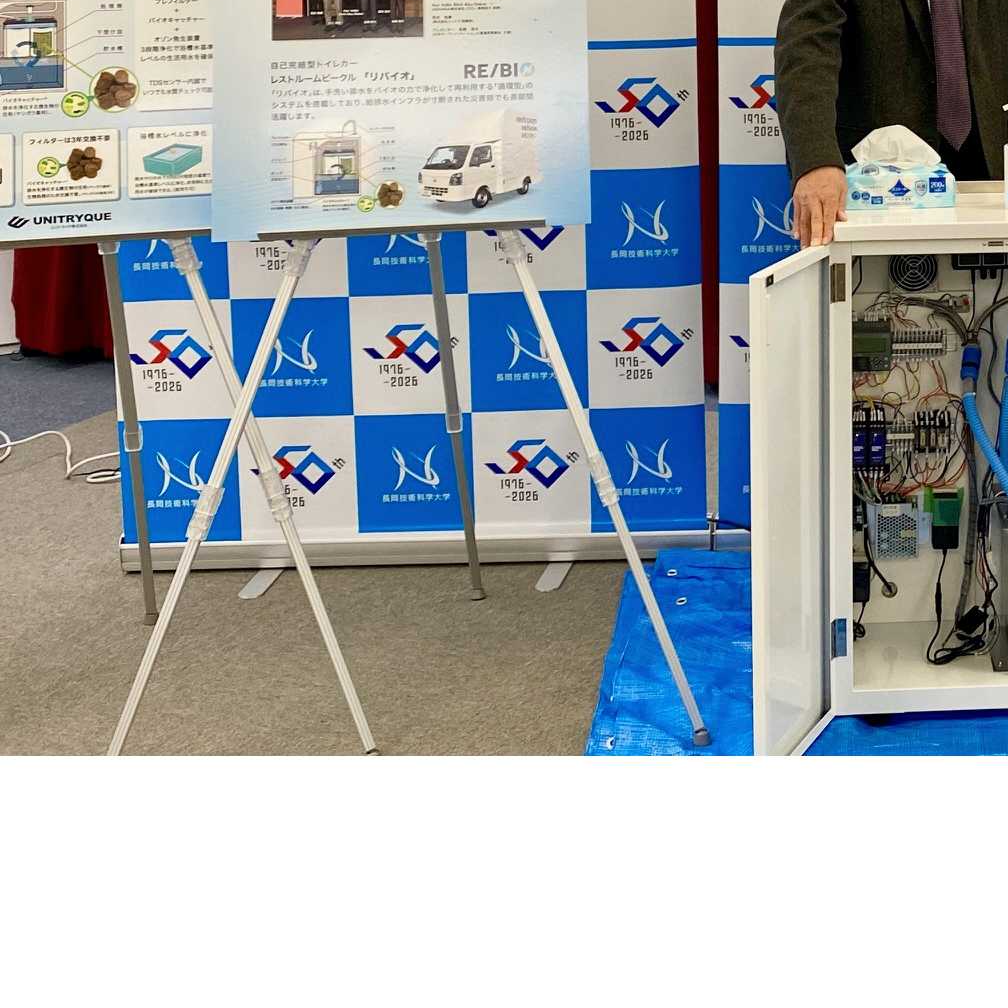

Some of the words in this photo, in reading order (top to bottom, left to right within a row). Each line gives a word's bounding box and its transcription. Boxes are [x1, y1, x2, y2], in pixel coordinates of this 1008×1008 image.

[614, 130, 649, 141] -2026
[746, 126, 780, 137] -2026
[33, 213, 112, 225] UNITRYQUE
[611, 247, 679, 259] 長岡技術科学大学
[619, 369, 653, 380] -2026
[147, 382, 183, 392] -2026
[383, 376, 418, 387] -2026
[382, 495, 450, 503] 長岡技術科学大学
[504, 491, 539, 501] -2026
